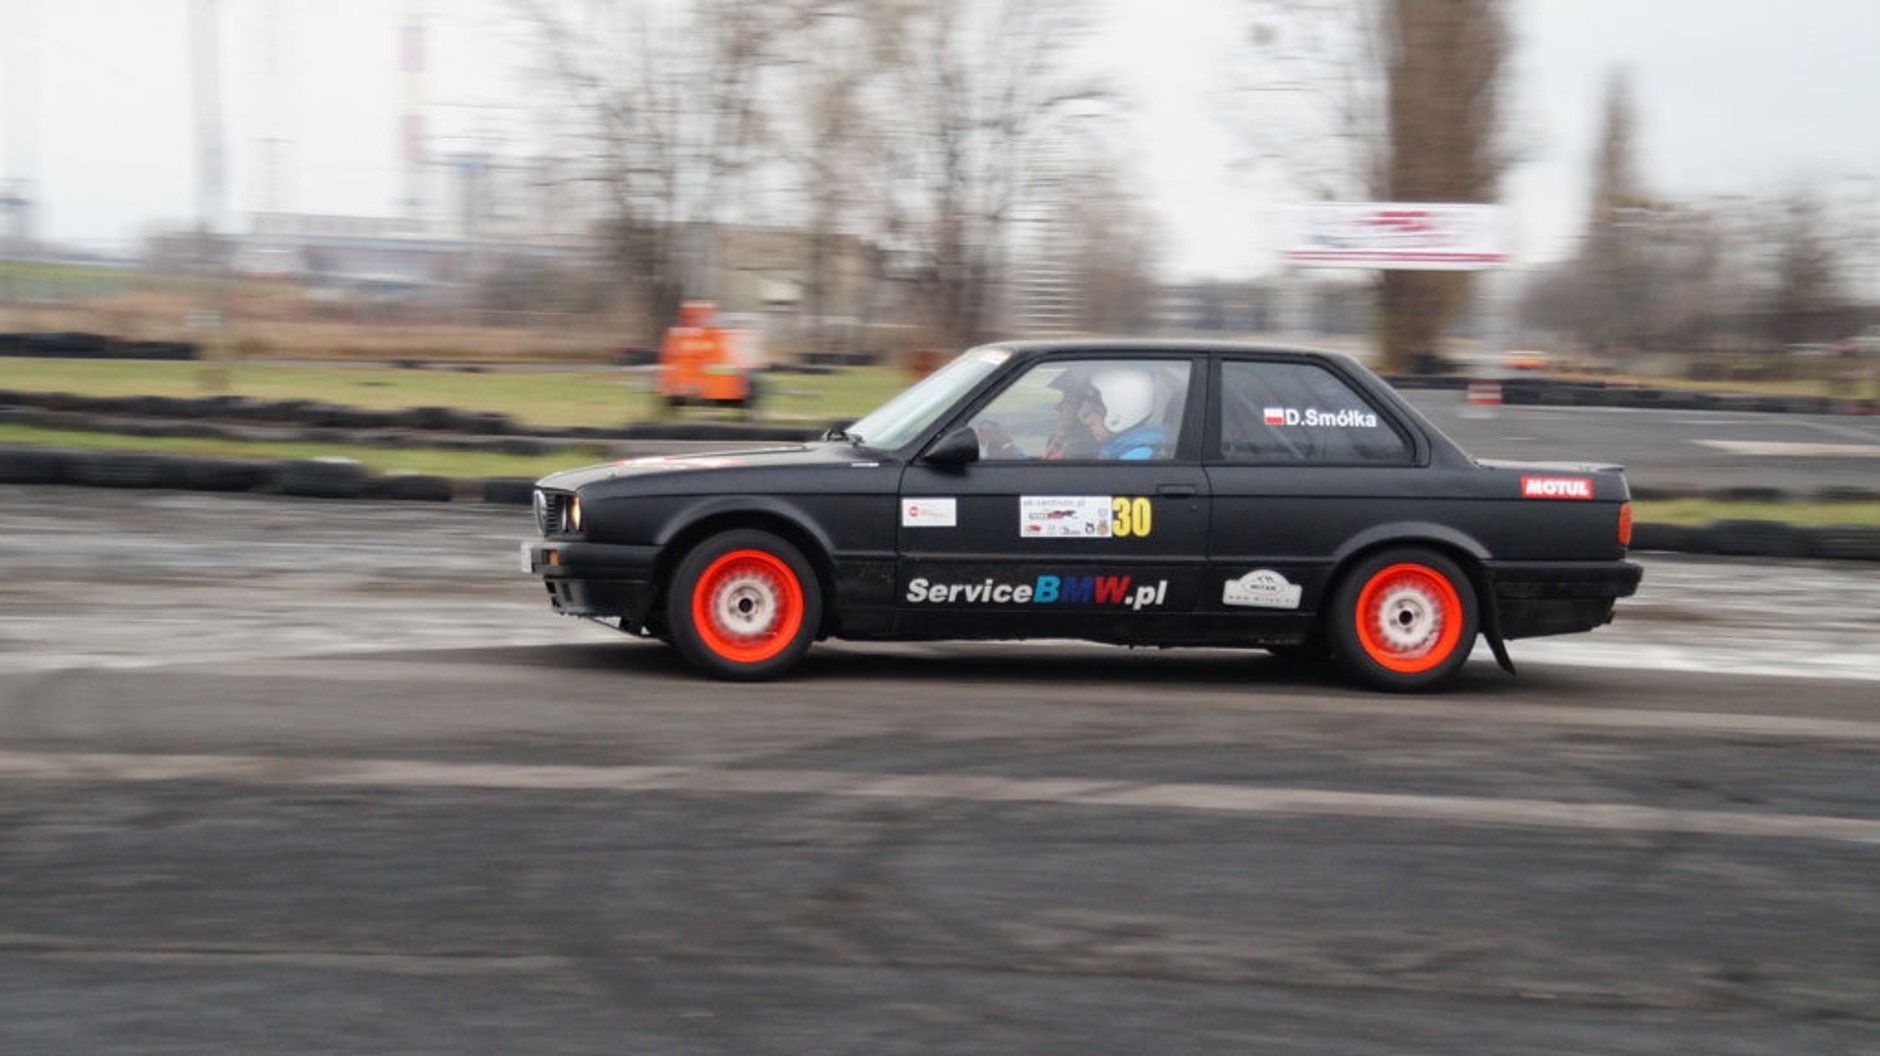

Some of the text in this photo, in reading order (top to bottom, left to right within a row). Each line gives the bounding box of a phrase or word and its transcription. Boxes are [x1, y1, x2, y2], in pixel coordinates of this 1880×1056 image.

[1285, 409, 1377, 427] D.Smółka
[1526, 480, 1588, 495] MOTUL
[1112, 497, 1150, 537] 30
[906, 576, 1168, 610] ServiceBMW.pl
